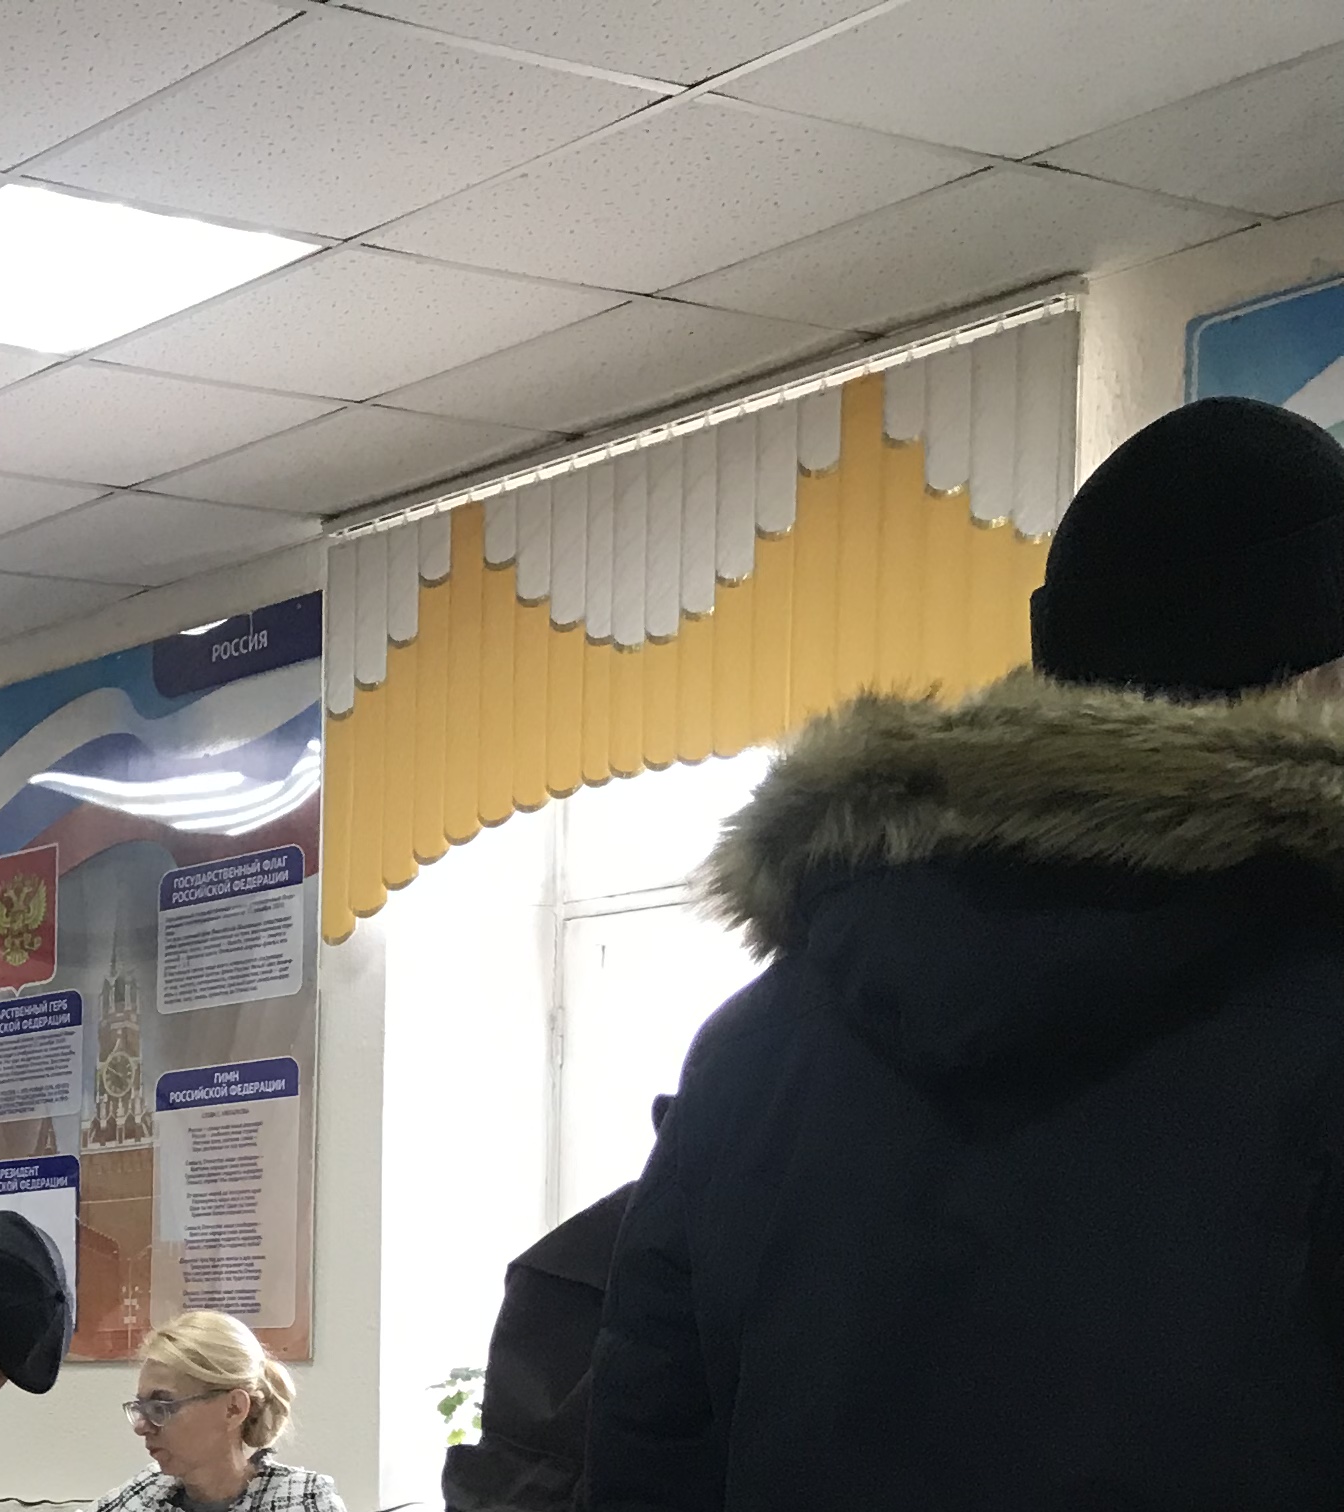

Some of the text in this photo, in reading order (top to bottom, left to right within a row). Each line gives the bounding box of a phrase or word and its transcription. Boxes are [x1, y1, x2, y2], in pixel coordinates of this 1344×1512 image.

[212, 630, 268, 662] РОССИЯ
[173, 856, 288, 888] ГОСУДАРСТВЕННЫЙ ФЛАГ
[172, 871, 289, 903] РОССИЙСКОЙ ФЕДЕРАЦИИ
[22, 1013, 71, 1029] ФЕДЕРАЦИИ
[214, 1070, 239, 1083] ГИМН
[169, 1079, 285, 1103] РОССИЙСКОЙ ФЕДЕРАЦИИ
[20, 1177, 68, 1190] ФЕДЕРАЦИИ
